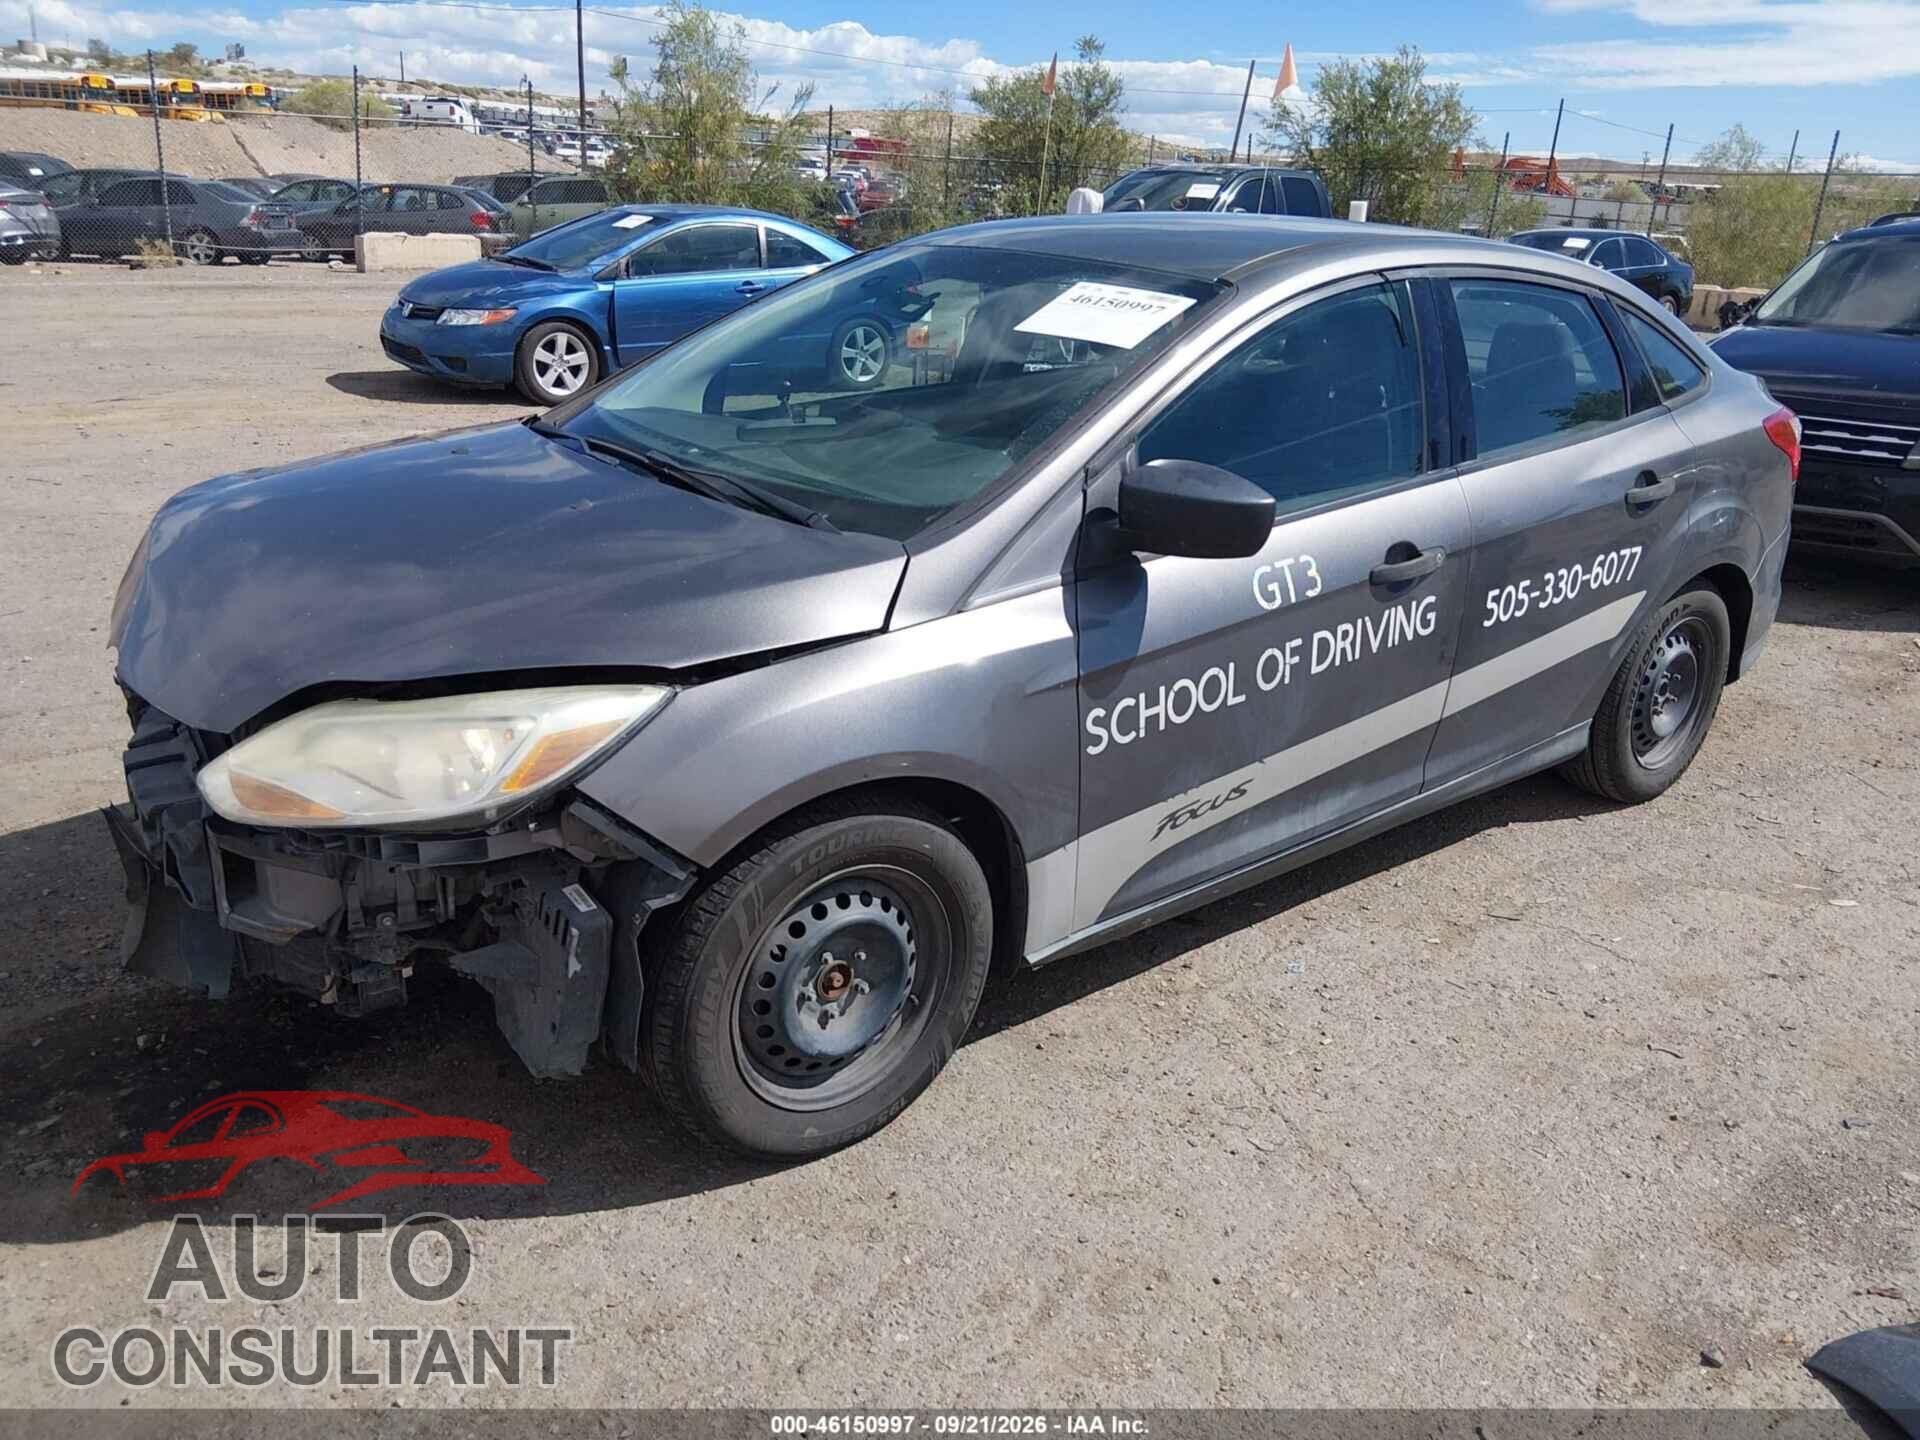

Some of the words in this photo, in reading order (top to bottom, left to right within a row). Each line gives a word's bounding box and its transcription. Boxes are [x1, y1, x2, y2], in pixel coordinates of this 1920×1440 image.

[1252, 554, 1323, 611] GT3
[1483, 545, 1643, 628] 505-330-6077
[1085, 661, 1246, 755] SCHOOL
[1256, 637, 1303, 691] OF
[1310, 595, 1437, 675] DRIVING
